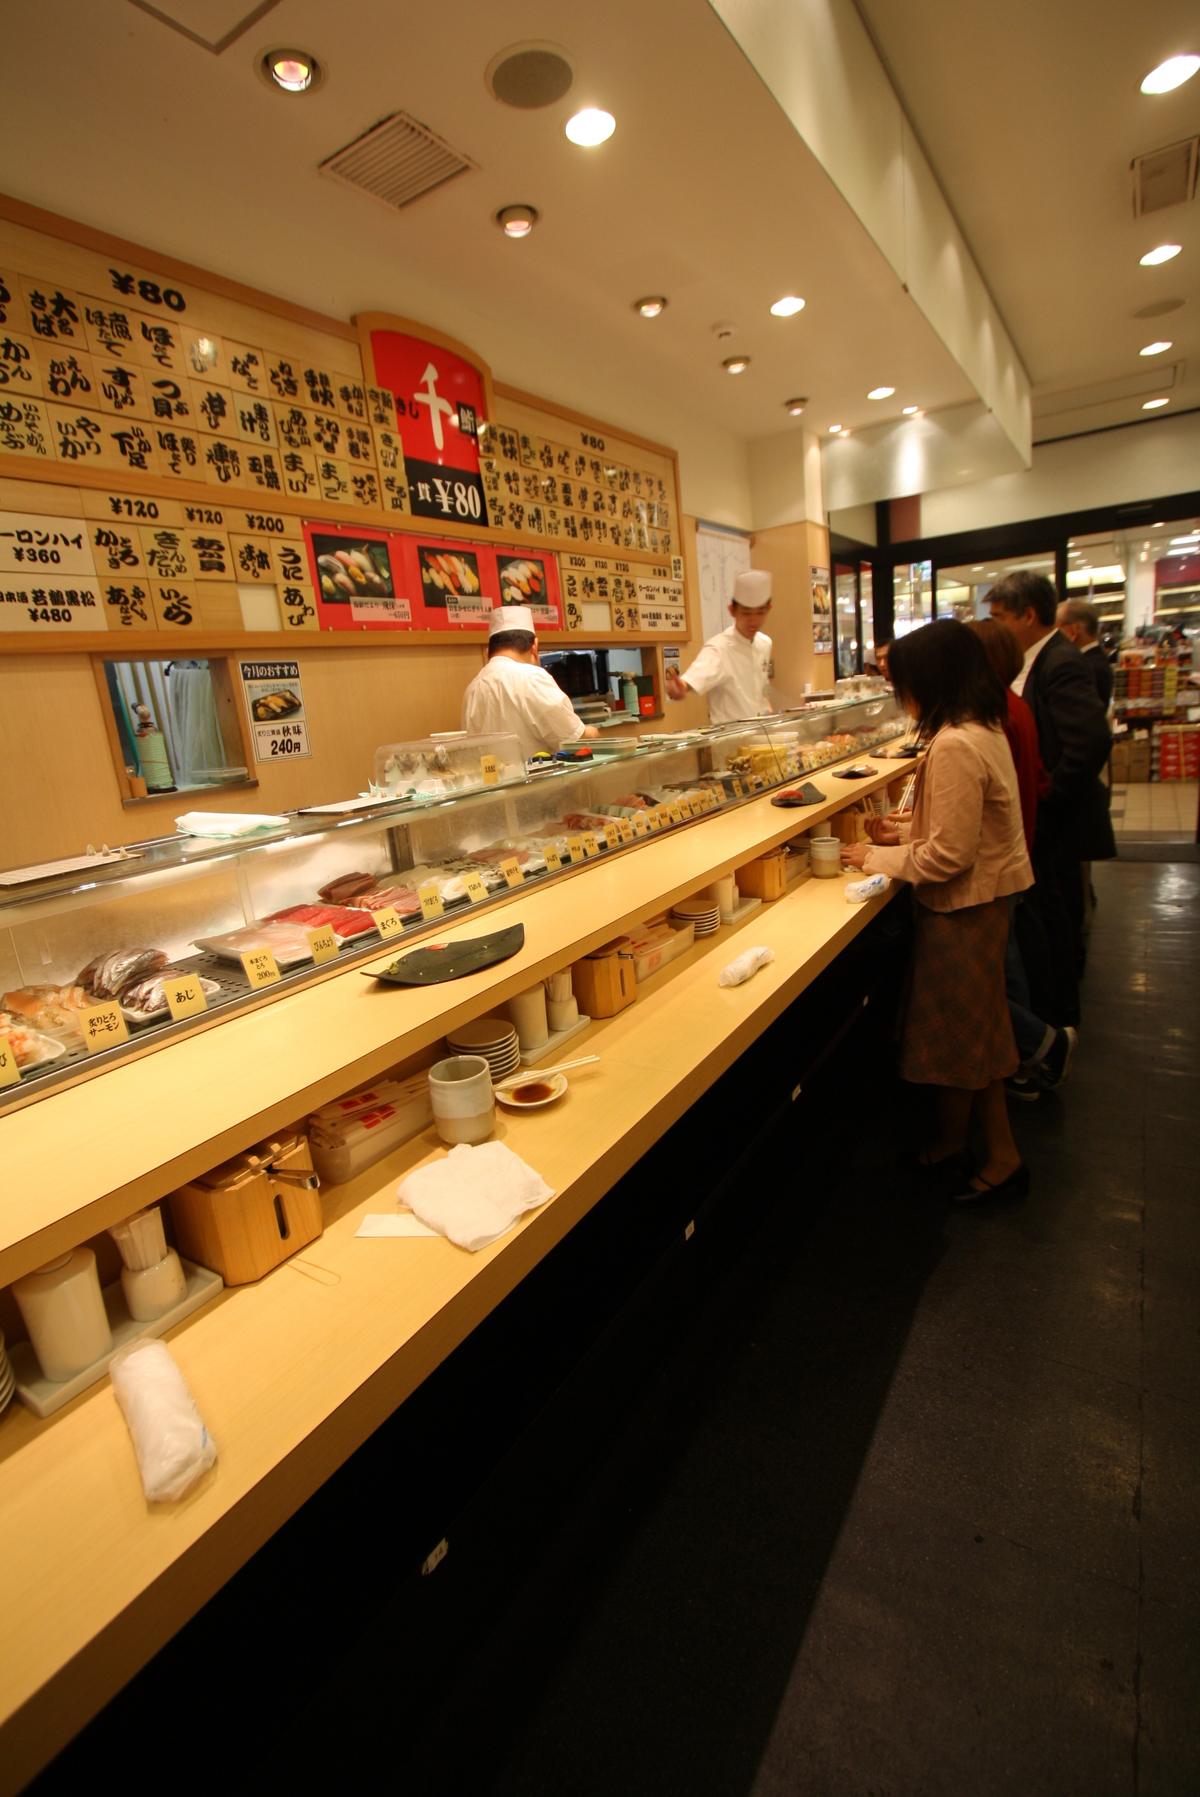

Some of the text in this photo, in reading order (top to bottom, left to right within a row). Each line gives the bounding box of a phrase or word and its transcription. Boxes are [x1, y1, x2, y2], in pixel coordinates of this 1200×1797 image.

[108, 268, 187, 312] ¥80
[108, 496, 159, 519] ¥120
[431, 477, 483, 521] ¥80
[184, 507, 223, 525] ¥120
[245, 513, 285, 533] ¥200
[12, 546, 61, 564] ¥360
[277, 547, 304, 581] うに
[27, 607, 72, 623] ¥480
[160, 588, 193, 625] いくら
[243, 664, 298, 679] 今月のおすすめ
[270, 738, 302, 756] 240円
[379, 917, 398, 931] まぐろ
[175, 988, 196, 1004] あじ
